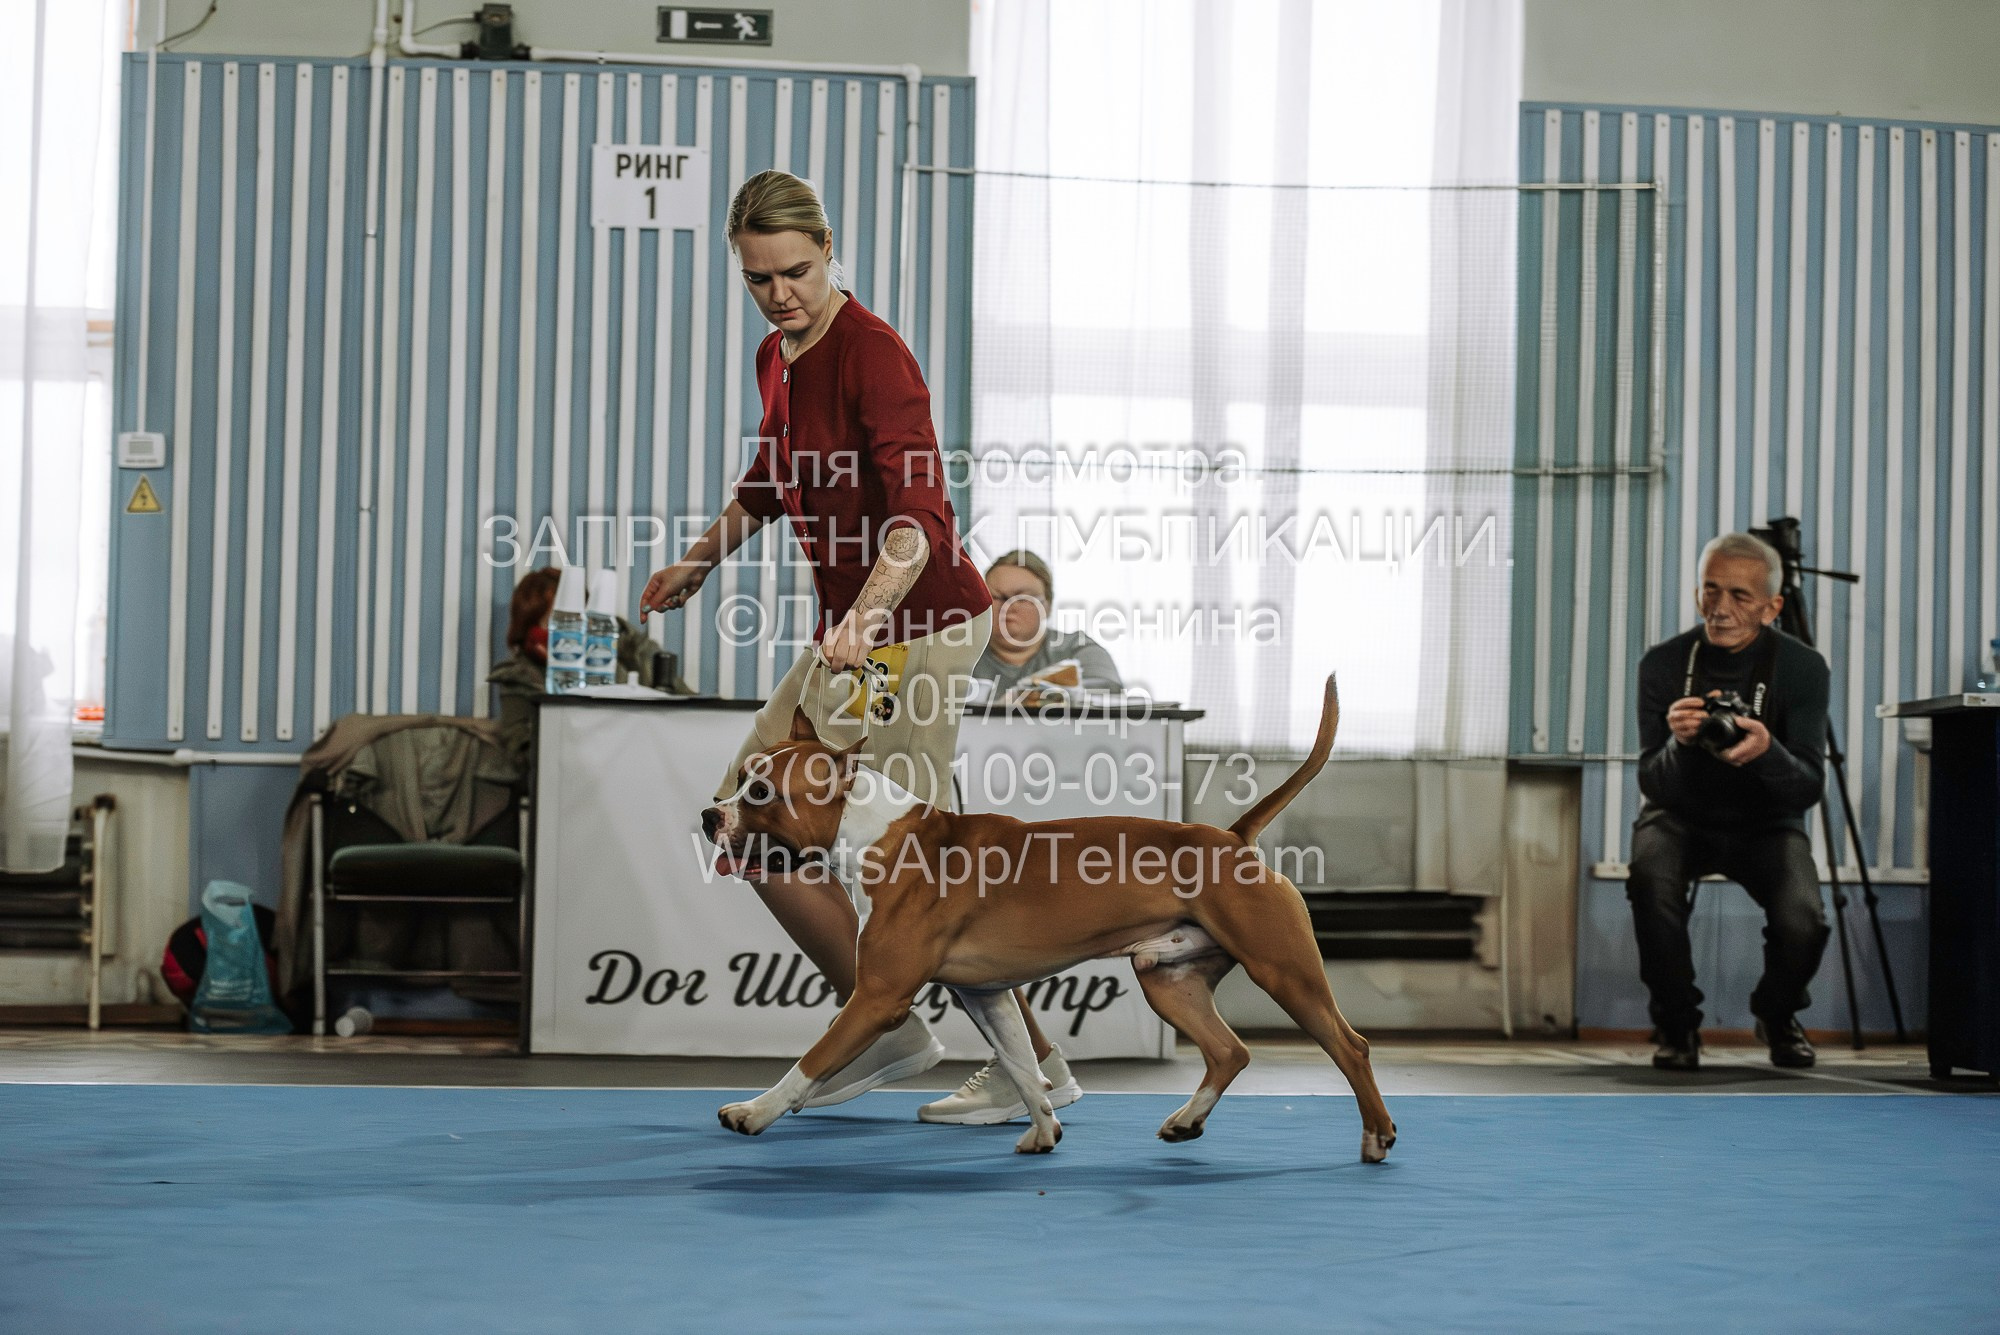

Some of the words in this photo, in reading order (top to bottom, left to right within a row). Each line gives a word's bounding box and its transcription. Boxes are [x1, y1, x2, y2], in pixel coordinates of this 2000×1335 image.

[616, 153, 689, 179] РИНГ
[644, 186, 656, 219] 1
[585, 949, 708, 1005] Дог
